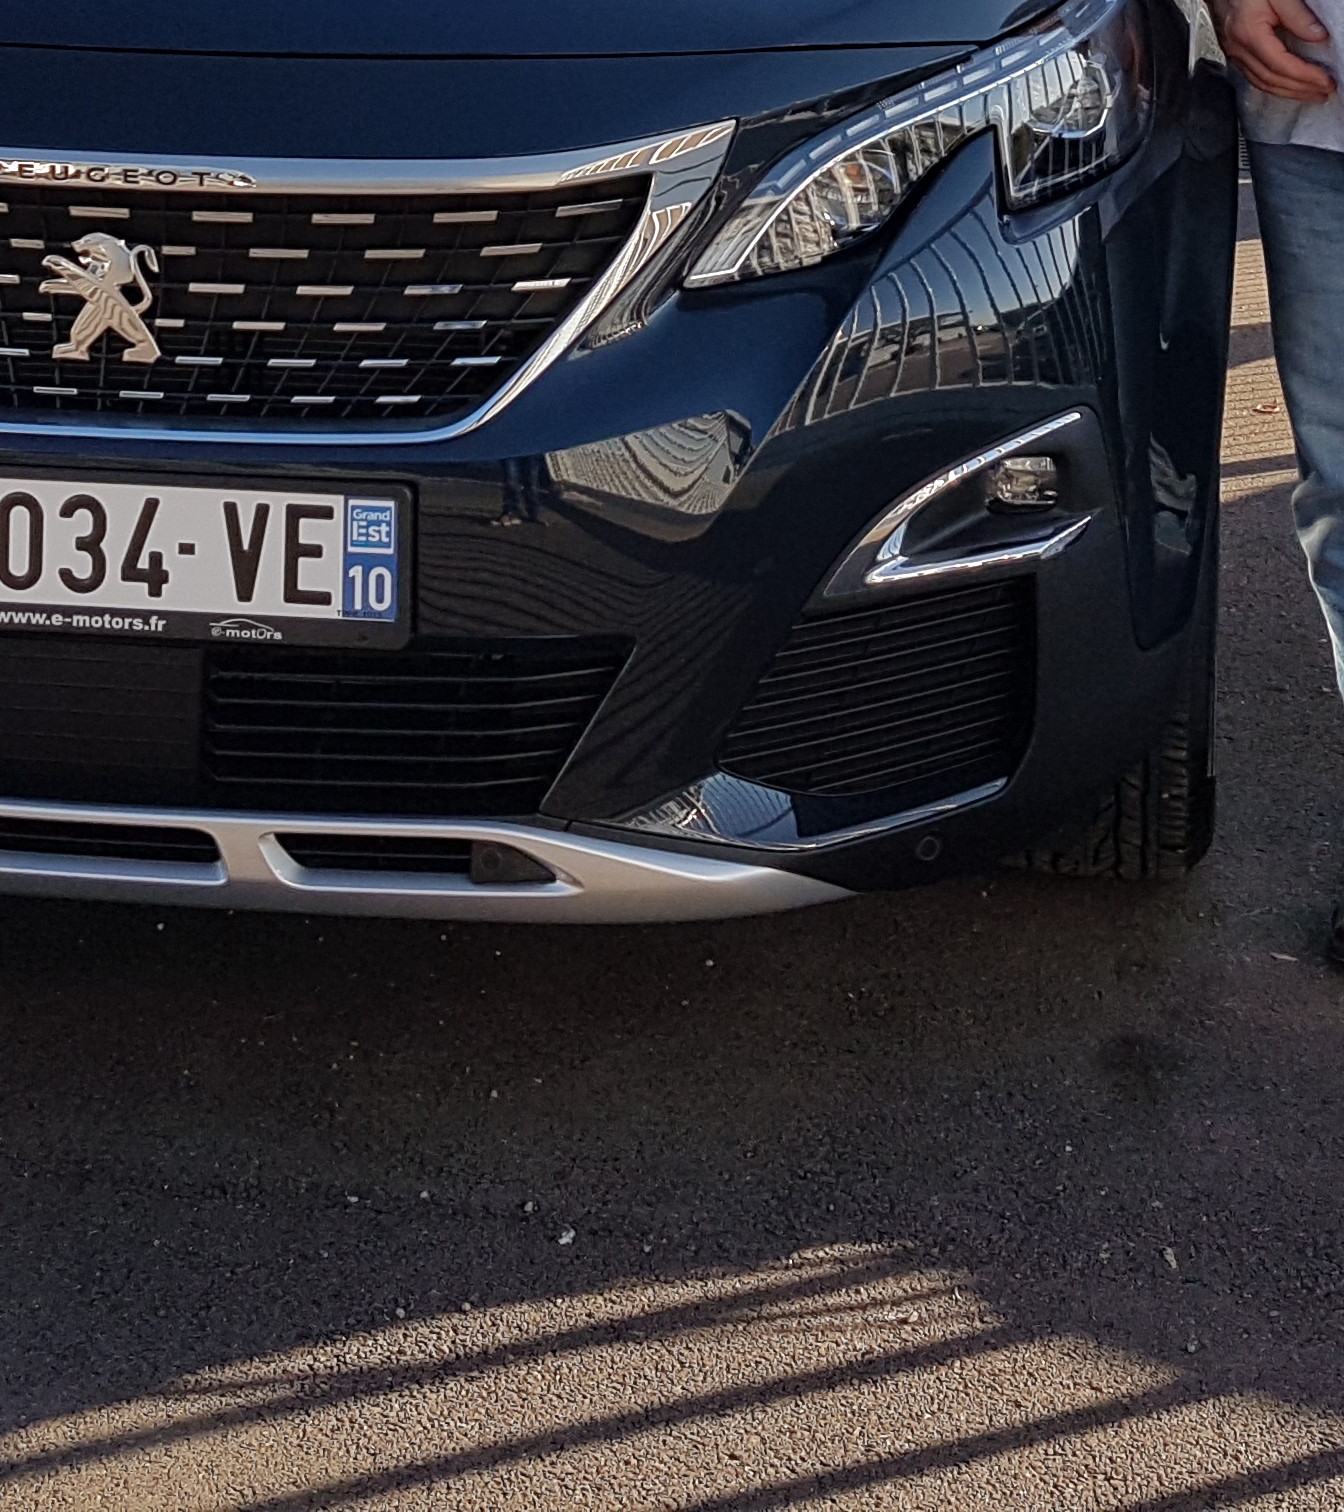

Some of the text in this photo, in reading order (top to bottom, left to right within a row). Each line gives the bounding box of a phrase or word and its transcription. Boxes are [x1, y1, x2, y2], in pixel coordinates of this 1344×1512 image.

[352, 508, 391, 522] Grand
[352, 520, 390, 543] Est
[348, 565, 393, 611] 10
